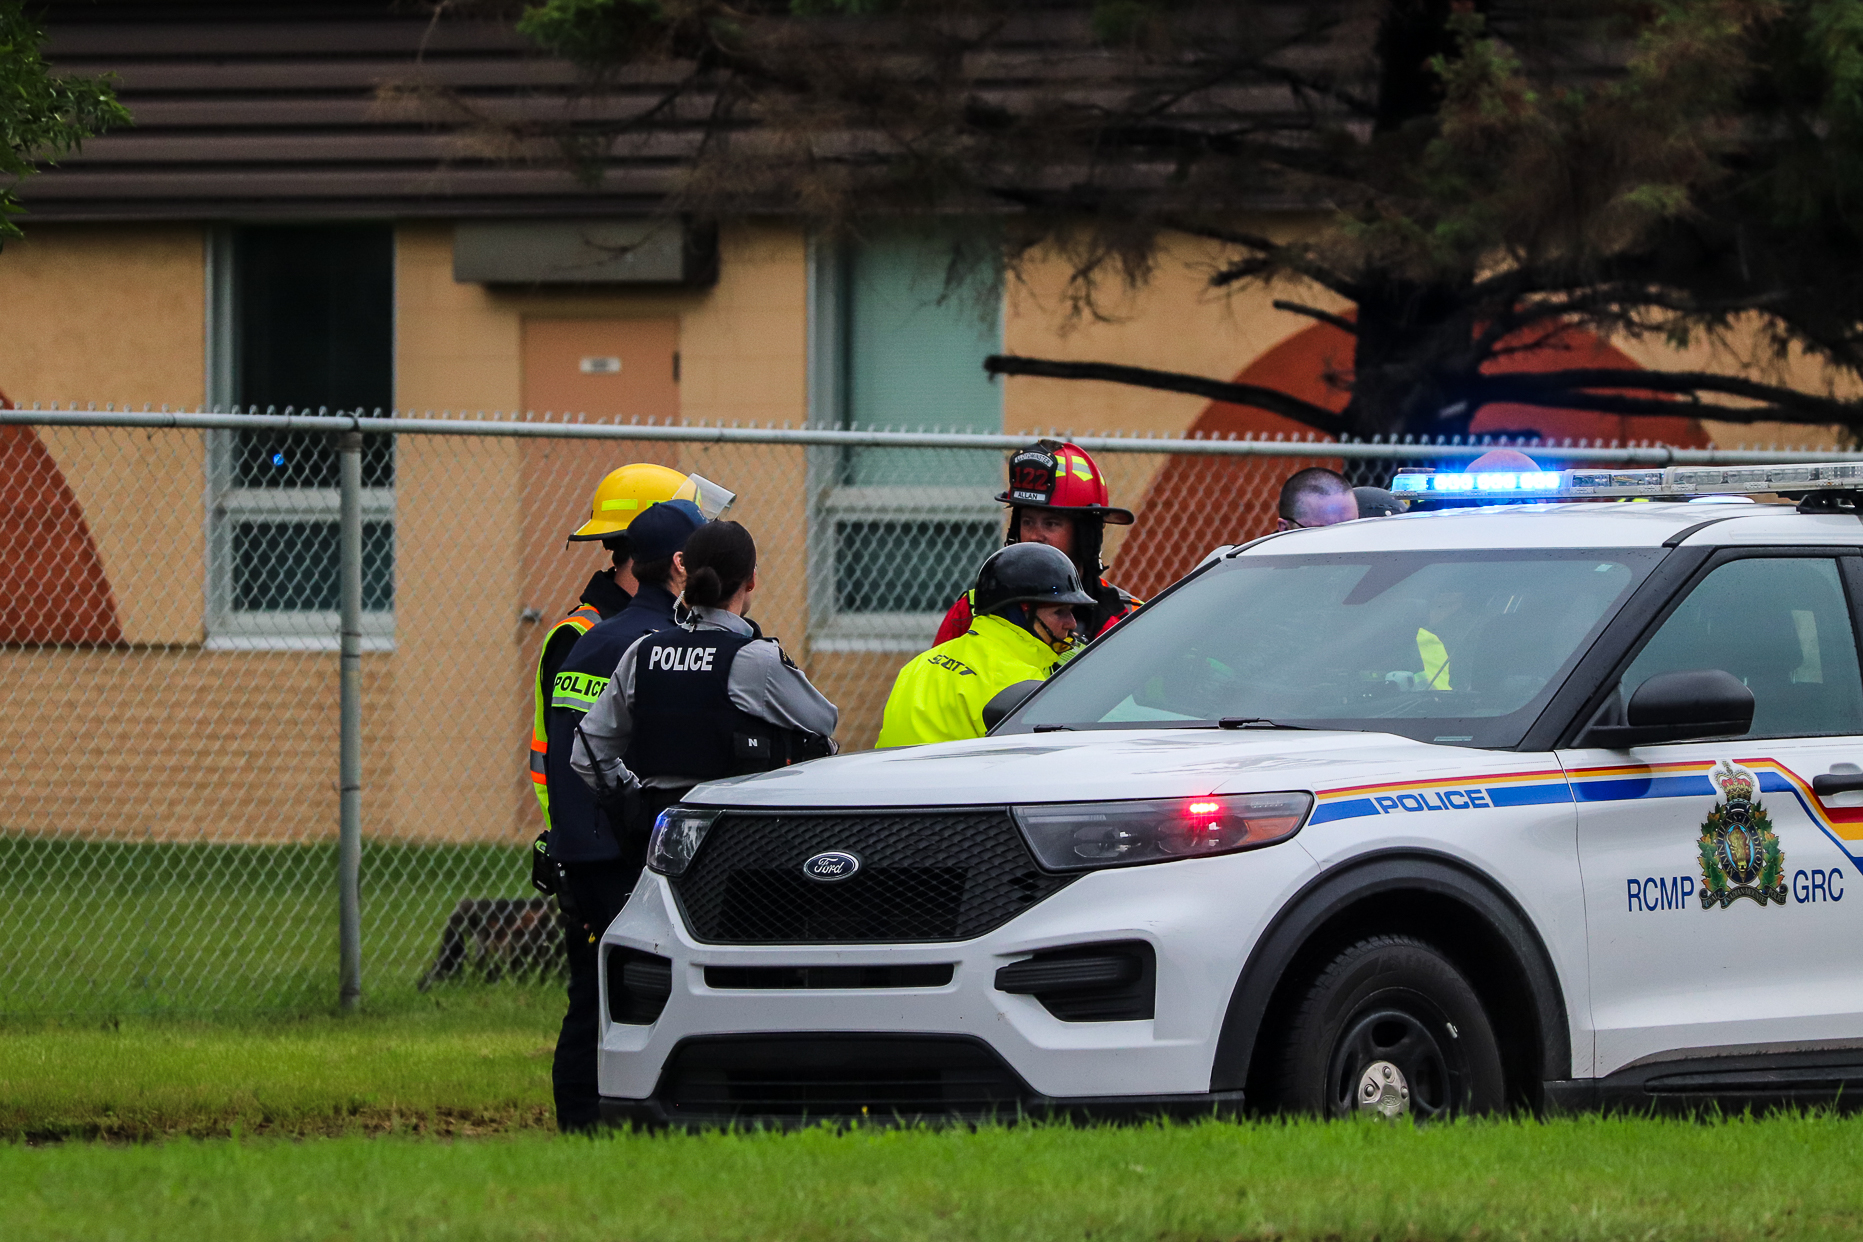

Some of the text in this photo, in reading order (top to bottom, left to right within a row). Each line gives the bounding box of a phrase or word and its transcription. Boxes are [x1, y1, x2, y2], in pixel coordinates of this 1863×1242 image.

[1013, 467, 1049, 491] 122
[1018, 491, 1038, 500] ALLAN
[649, 645, 717, 671] POLICE
[1373, 788, 1491, 814] POLICE
[813, 857, 845, 874] Ford
[1627, 876, 1695, 912] RCMP
[1792, 867, 1844, 904] GRC
